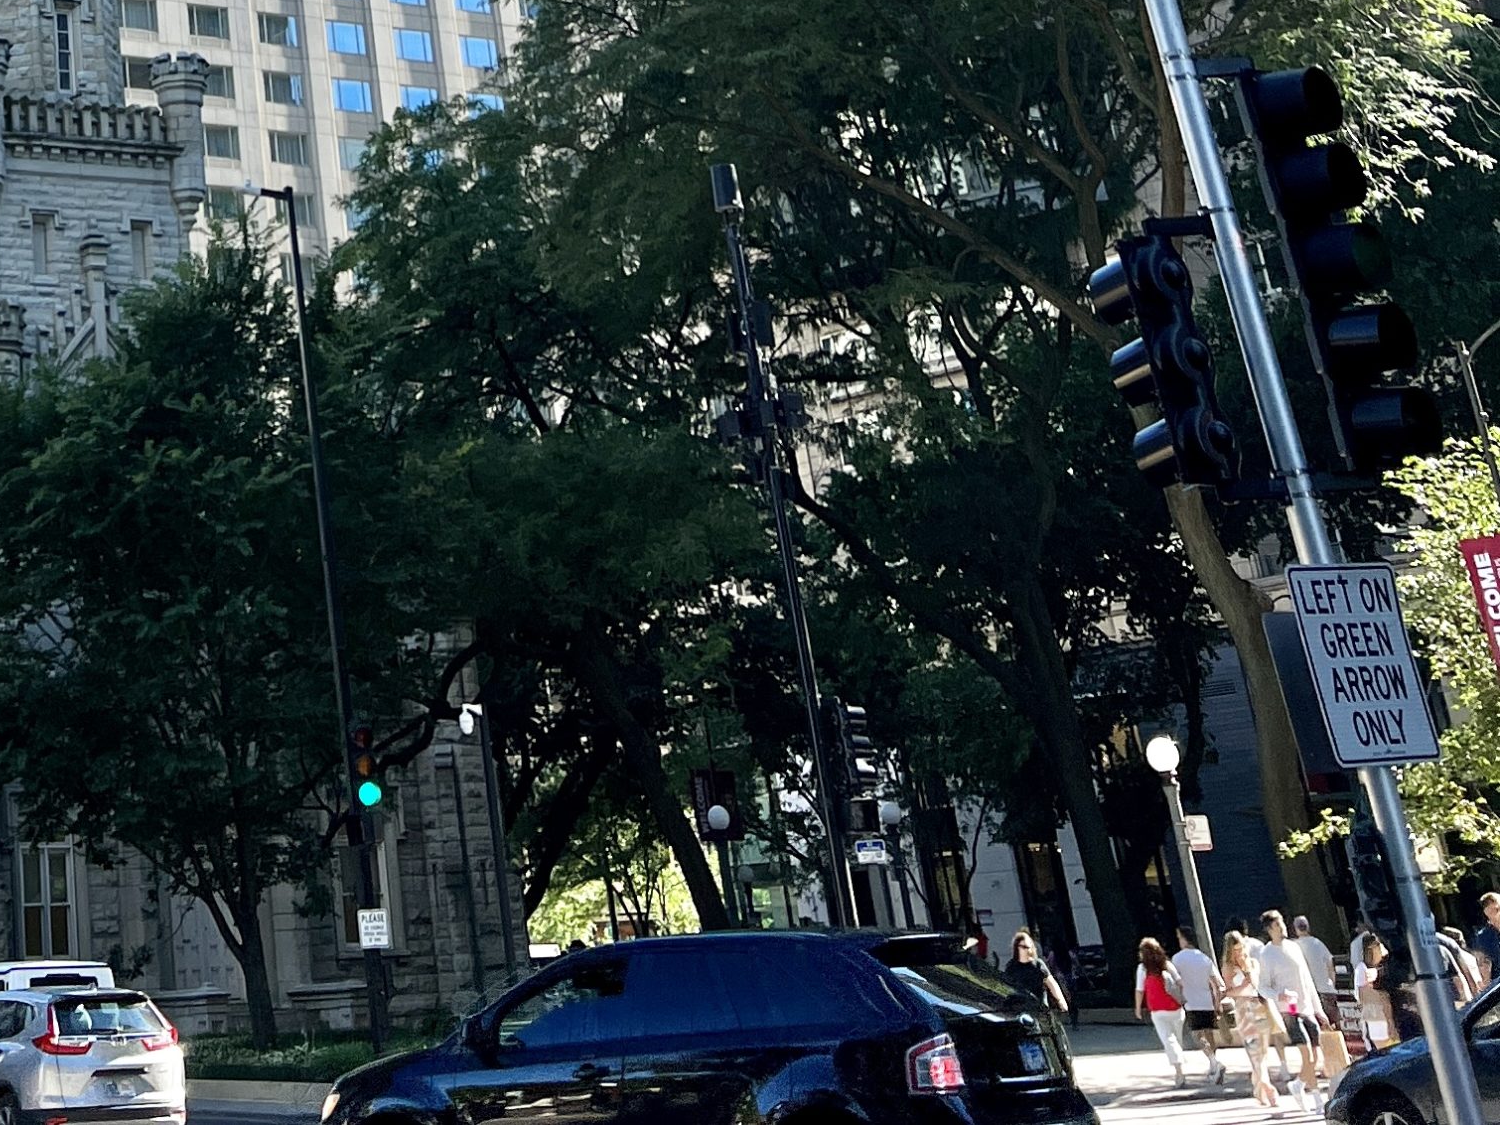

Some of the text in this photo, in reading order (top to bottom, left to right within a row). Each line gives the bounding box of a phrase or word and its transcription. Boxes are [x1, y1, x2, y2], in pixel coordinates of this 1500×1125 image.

[1297, 577, 1393, 615] LEFT ON
[1473, 551, 1500, 649] COME
[1320, 621, 1394, 659] GREEN
[1331, 663, 1409, 704] ARROW
[1352, 708, 1407, 747] ONLY
[361, 913, 384, 923] PLEASE
